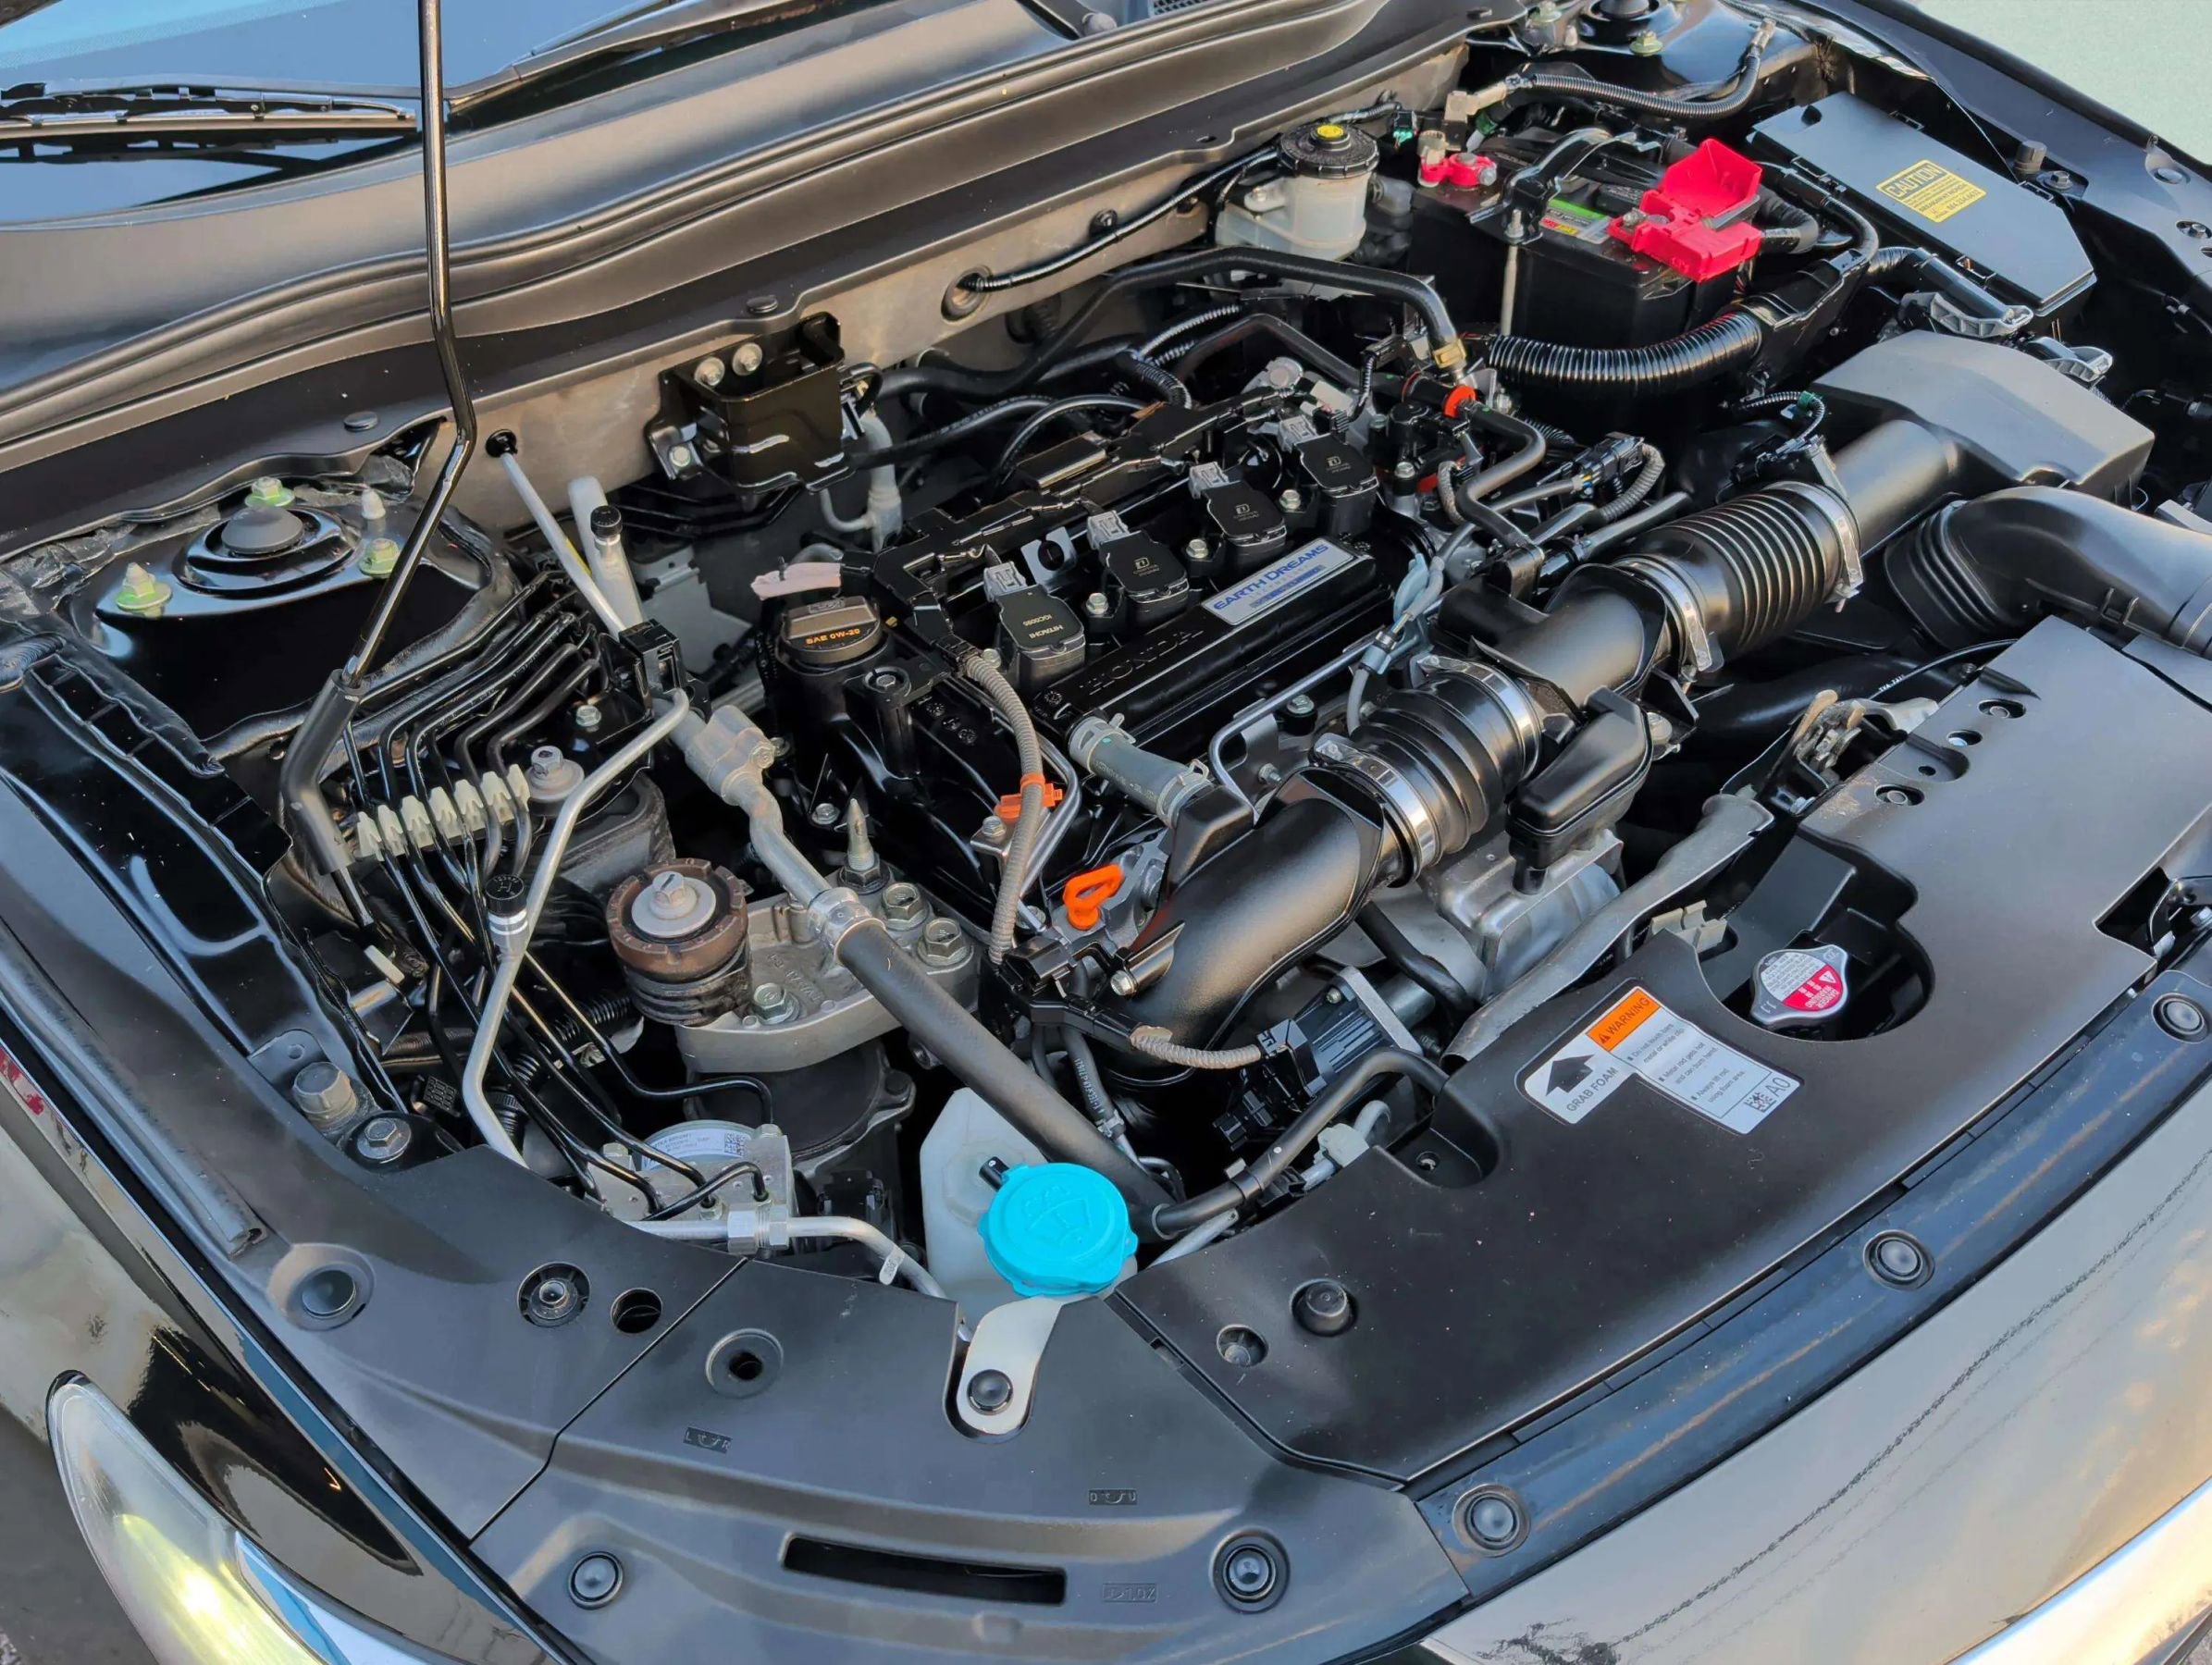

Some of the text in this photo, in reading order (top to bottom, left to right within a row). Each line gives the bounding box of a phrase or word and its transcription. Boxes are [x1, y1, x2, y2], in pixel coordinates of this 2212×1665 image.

[1885, 165, 1943, 197] CAUTION
[1213, 578, 1267, 610] EARTH
[1264, 543, 1329, 582] DREAMS
[806, 628, 860, 645] SAE 0W-20
[1079, 630, 1204, 695] HONDA
[1606, 997, 1650, 1036] WARNING
[1566, 1067, 1619, 1112] GRAB FOAM
